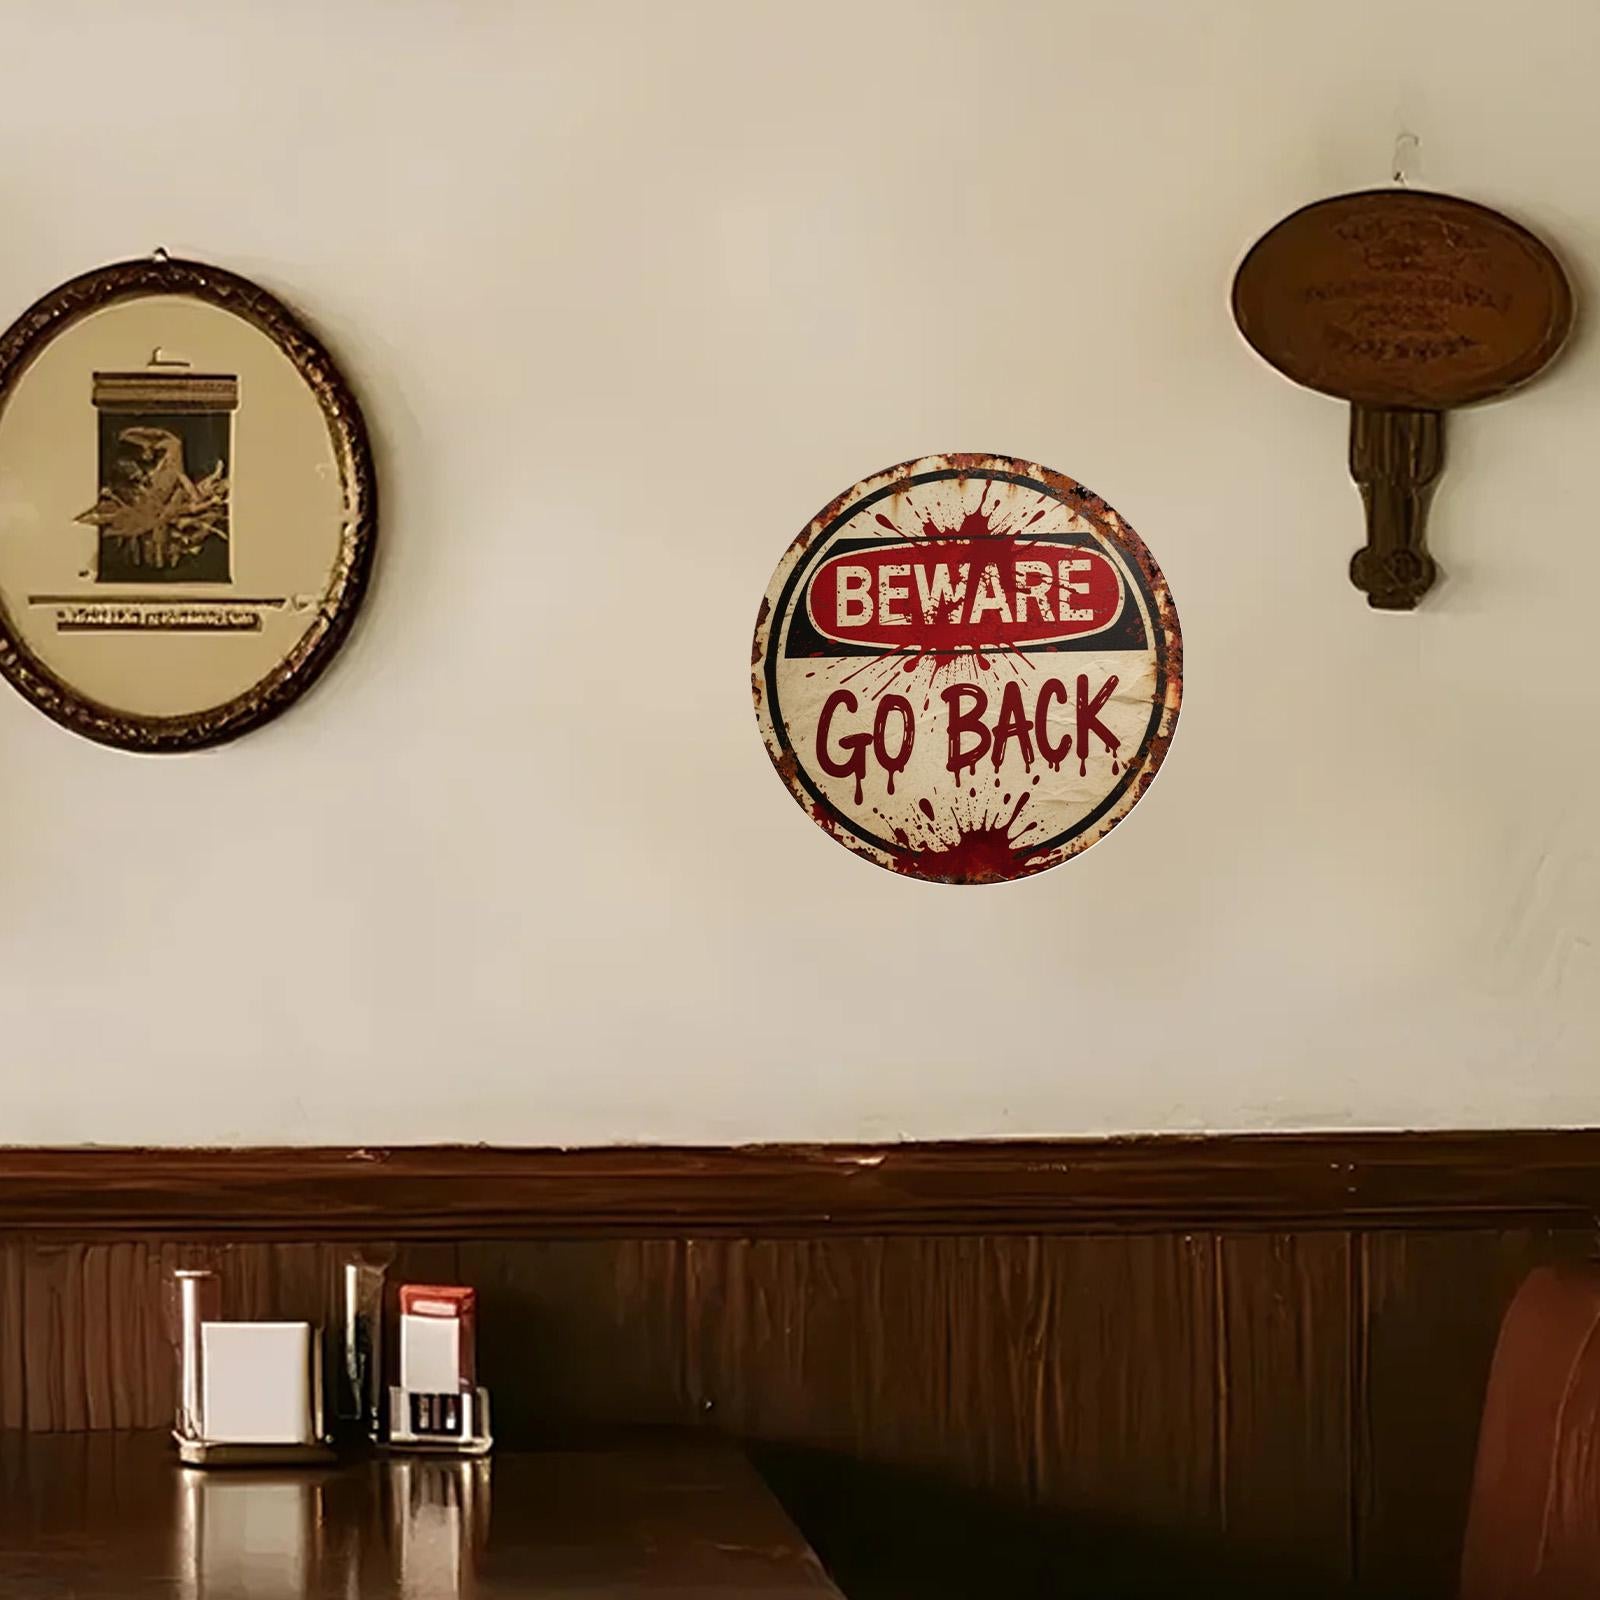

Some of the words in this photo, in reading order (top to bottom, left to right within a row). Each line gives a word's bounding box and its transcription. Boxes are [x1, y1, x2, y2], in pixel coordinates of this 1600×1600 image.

[835, 559, 1094, 628] BEWARE
[815, 689, 915, 803] GO
[941, 673, 1120, 786] BACK
